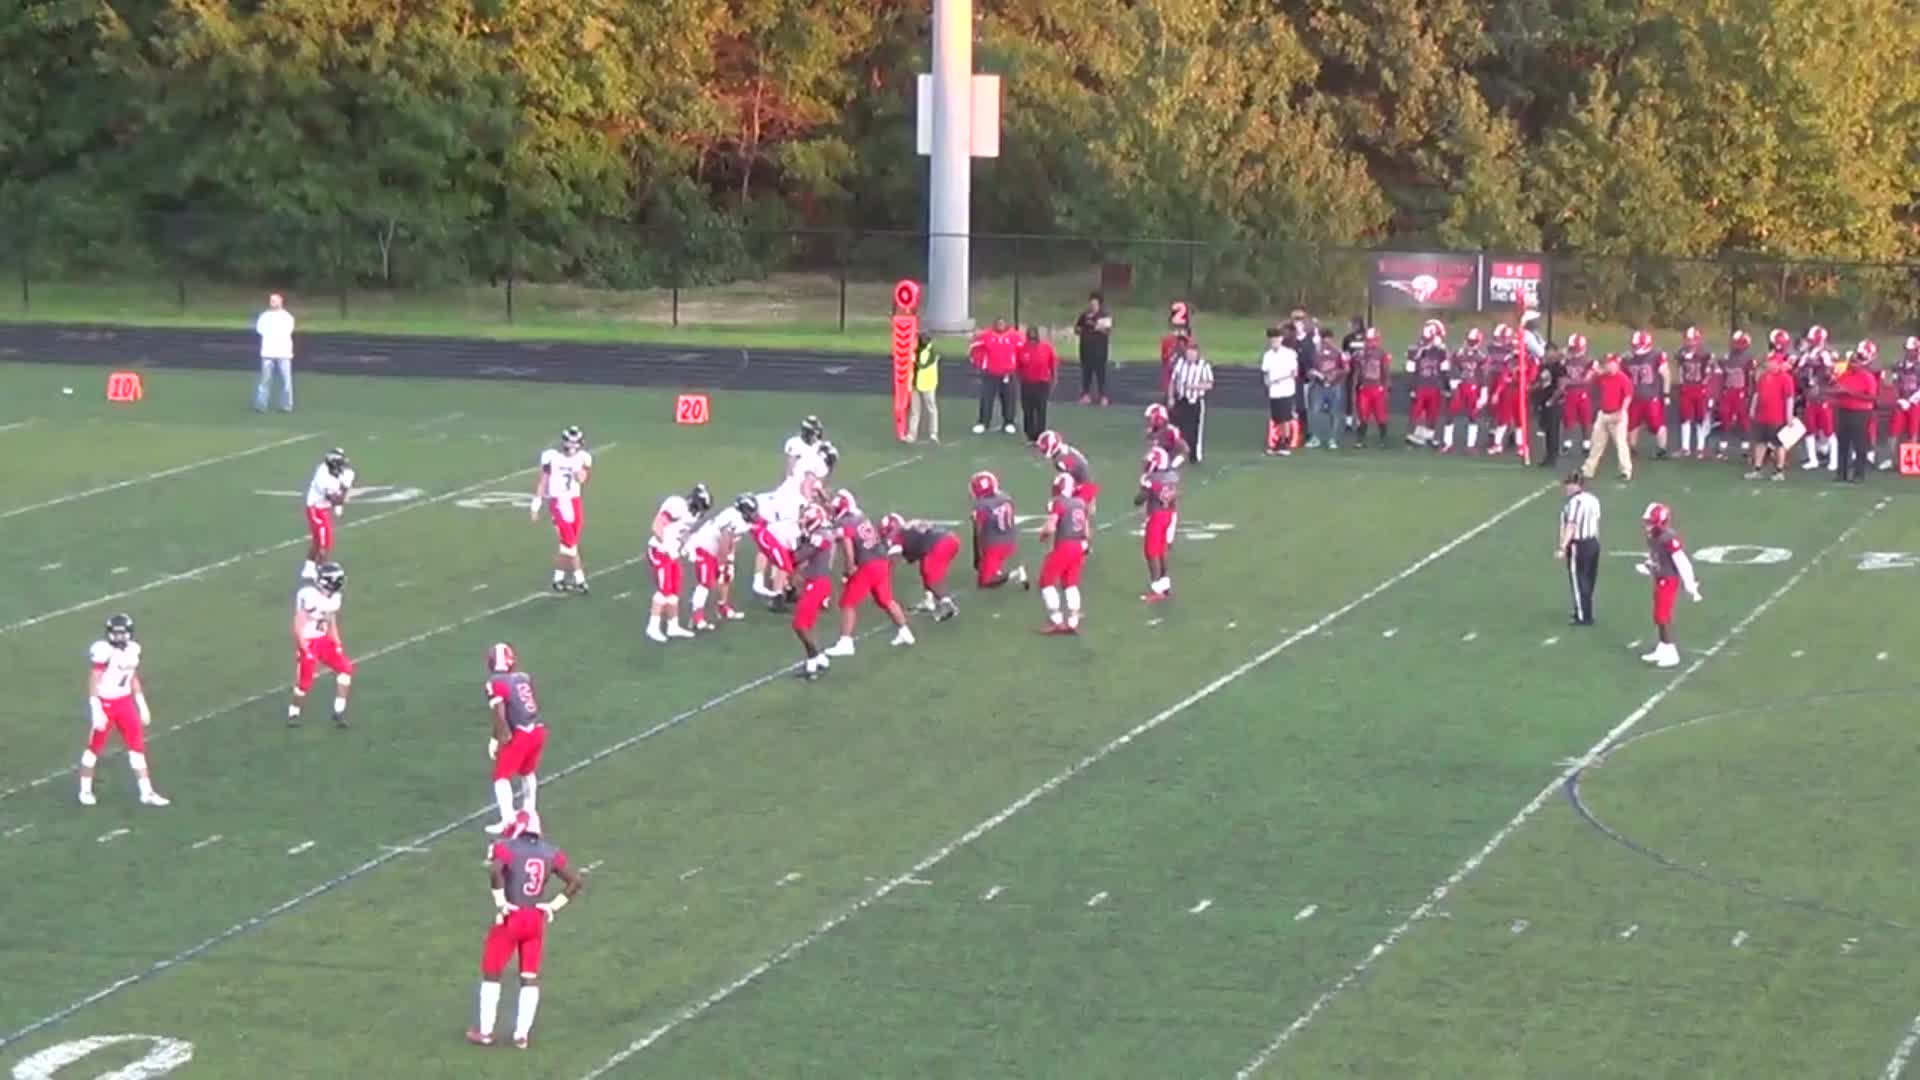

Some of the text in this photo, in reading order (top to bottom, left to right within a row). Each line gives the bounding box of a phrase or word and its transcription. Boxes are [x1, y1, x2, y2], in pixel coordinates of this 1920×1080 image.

[1490, 277, 1539, 291] PROTECT
[1171, 302, 1187, 325] 2
[111, 378, 132, 398] 10
[681, 399, 702, 420] 20
[523, 857, 545, 896] 3
